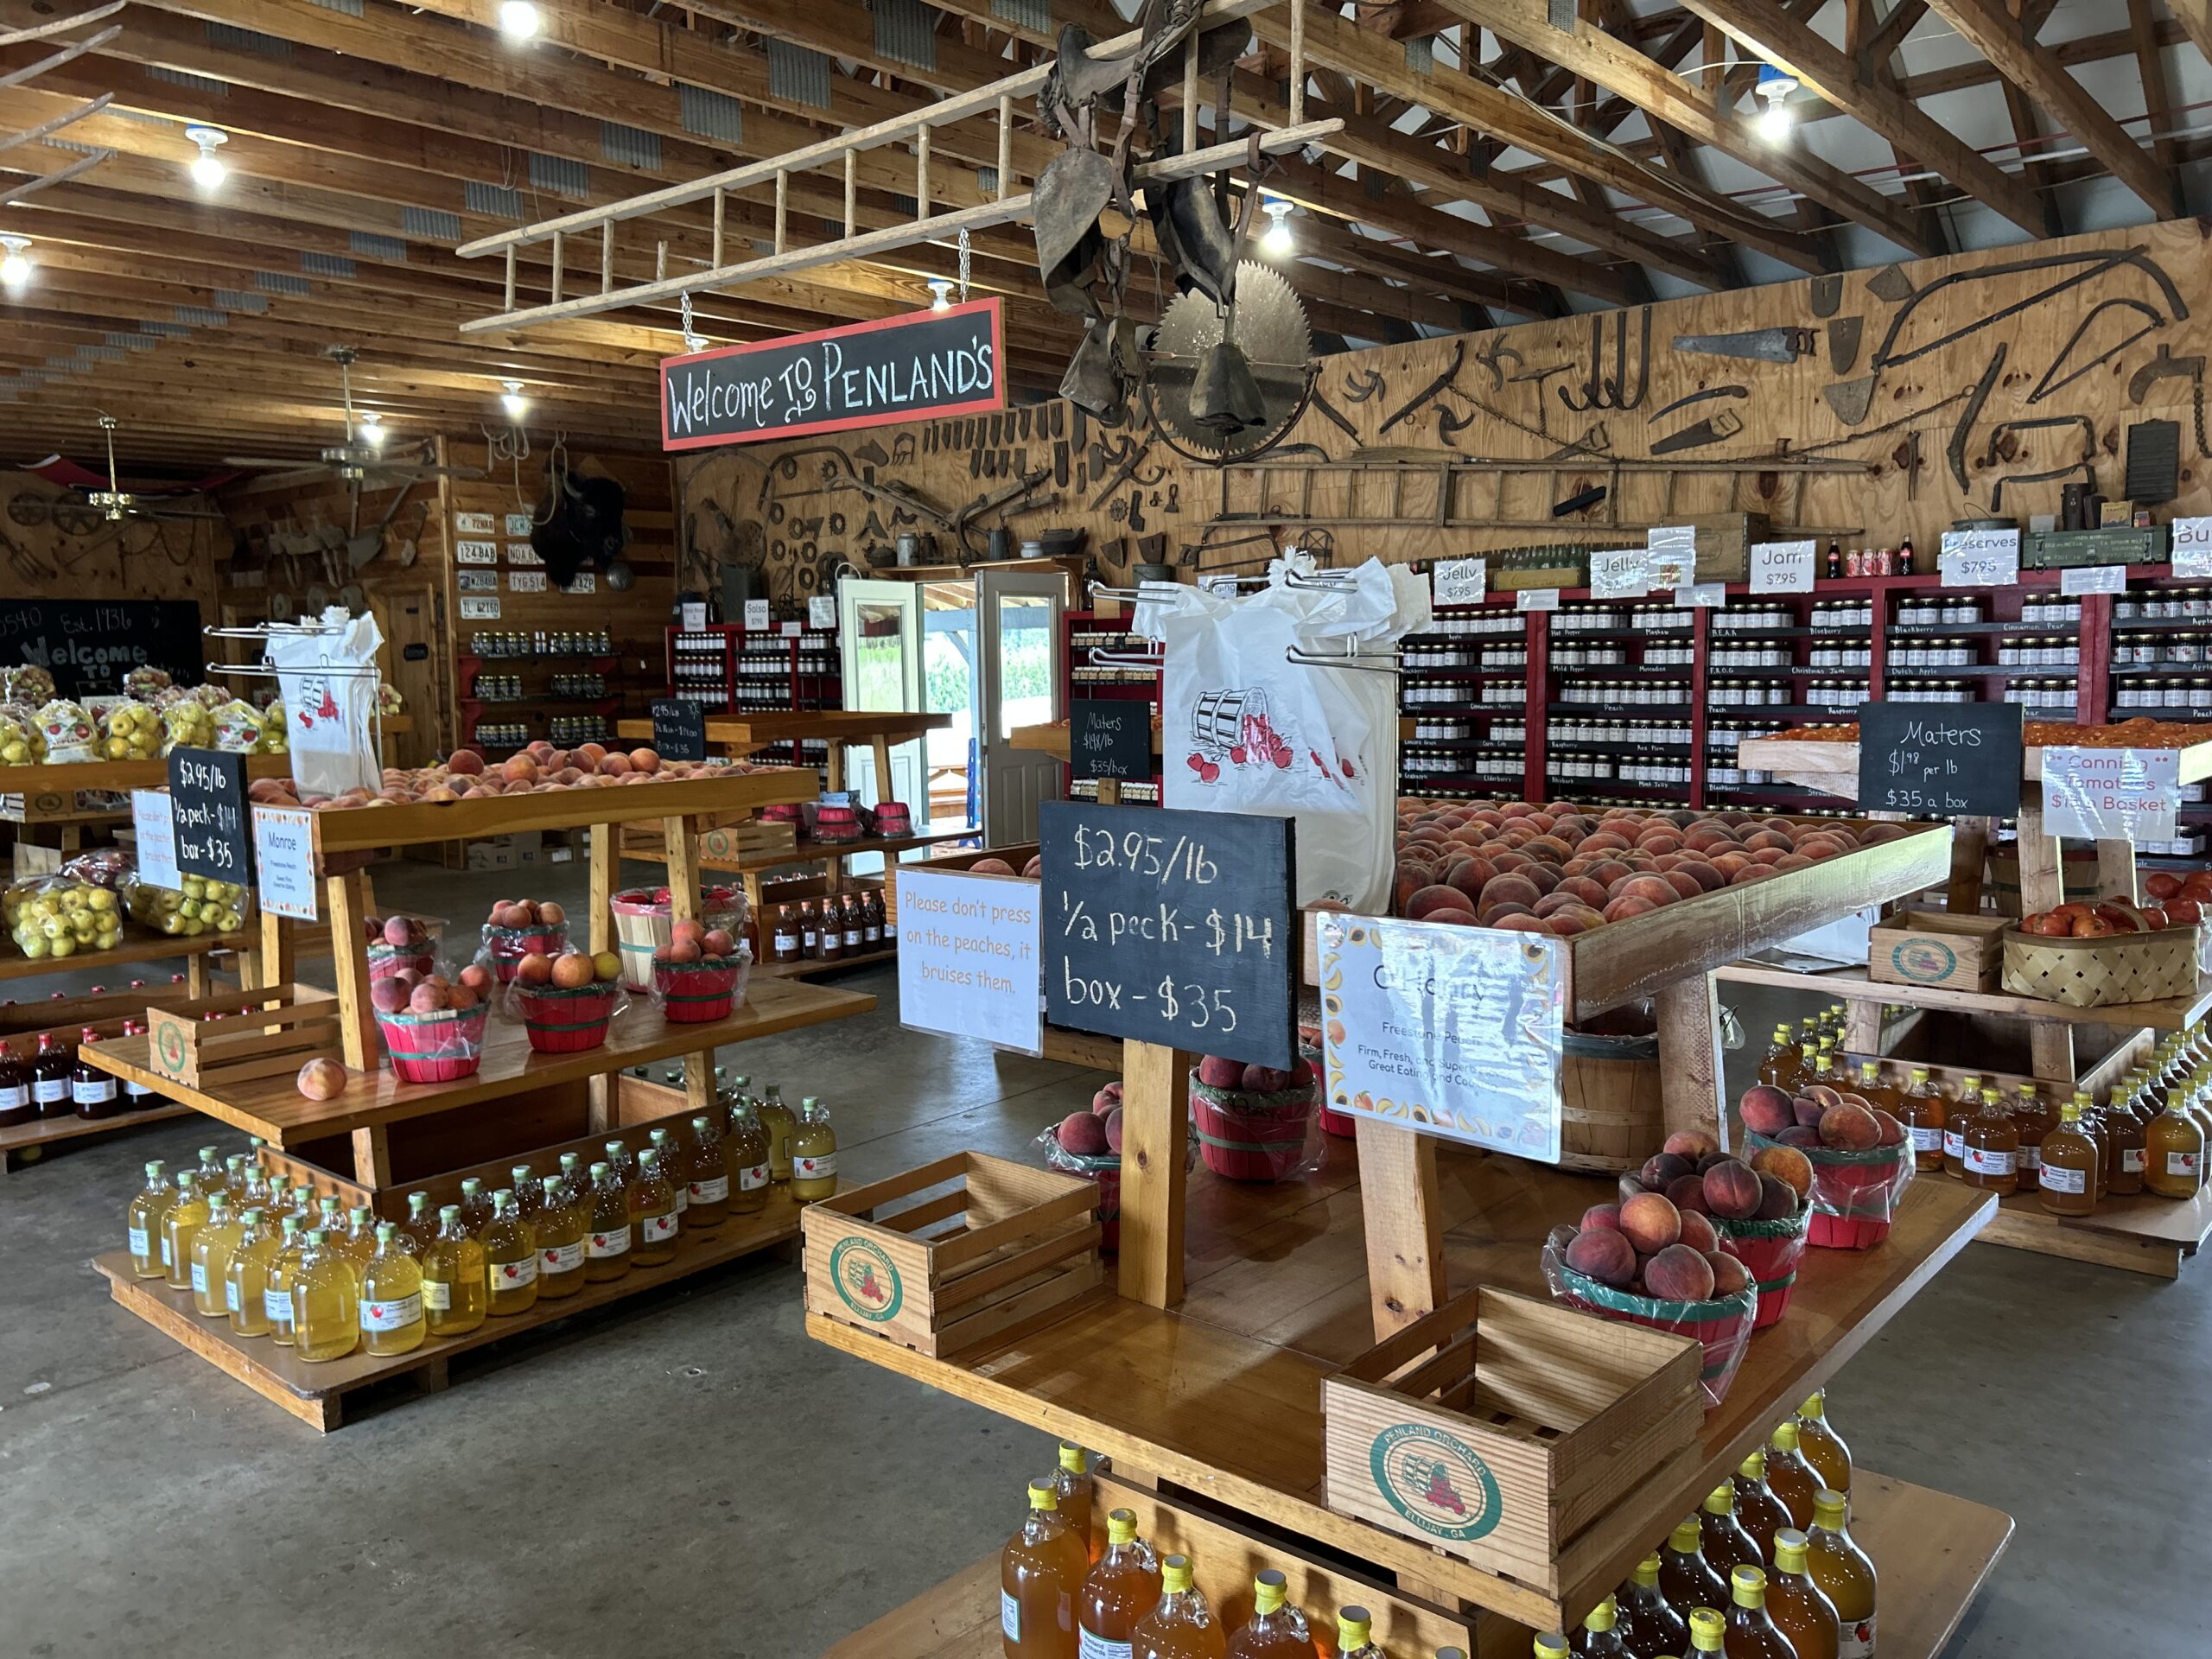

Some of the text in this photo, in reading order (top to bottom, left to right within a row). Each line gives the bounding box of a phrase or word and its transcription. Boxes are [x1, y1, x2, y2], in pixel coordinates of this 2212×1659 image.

[667, 334, 994, 435] Welcome TO PENLAND'S
[1944, 535, 2018, 550] Preserves
[1762, 550, 1802, 566] Jam
[1198, 582, 1236, 594] Drssing
[747, 603, 766, 614] Salsa
[1809, 627, 1842, 636] Blueberry
[21, 635, 148, 668] Welcome
[82, 664, 111, 679] TO
[1791, 666, 1825, 675] Christmas
[1891, 667, 1914, 676] Dutch
[1604, 703, 1624, 712] Peach
[1827, 707, 1858, 715] Raspberry
[1086, 712, 1122, 731] Maters
[1900, 720, 1982, 747] Maters
[1923, 765, 1943, 782] per
[1946, 760, 1958, 775] lb
[2069, 754, 2148, 772] Cannig
[1709, 784, 1740, 792] Blackberry
[2064, 775, 2156, 791] Tomats
[1885, 789, 1969, 810] $35 a box
[2103, 796, 2167, 811] Basket
[268, 831, 296, 850] Monroe
[905, 891, 1031, 925] Please don't press
[906, 927, 1031, 961] on the peaches, it
[921, 960, 1016, 994] bruises them.
[1158, 975, 1237, 1033] $35
[1357, 1044, 1382, 1059] Firm,
[1382, 1049, 1414, 1065] Fresh,
[1369, 1059, 1395, 1073] Great
[1396, 1064, 1430, 1080] Eating
[863, 1240, 894, 1272] ORCHARD
[1383, 1426, 1486, 1476] PENLAND ORCHARD
[1404, 1509, 1466, 1539] ELLIJAY GA
